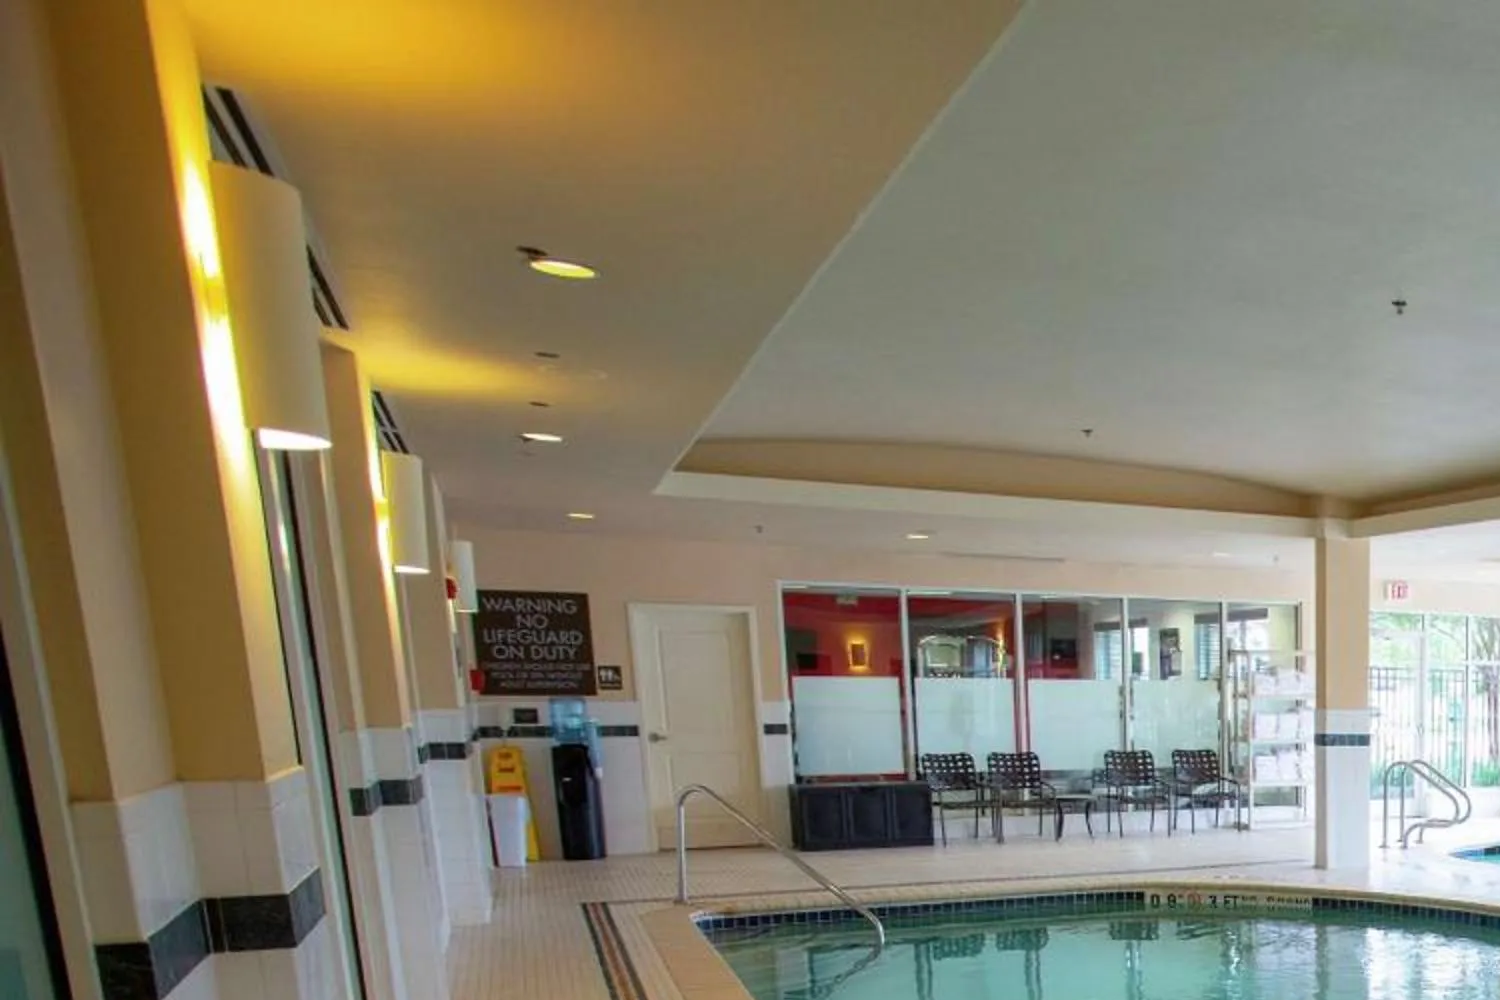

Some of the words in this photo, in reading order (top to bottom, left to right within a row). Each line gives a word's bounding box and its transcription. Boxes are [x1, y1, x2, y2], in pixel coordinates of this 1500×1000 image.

[482, 597, 577, 615] WARNING
[516, 614, 549, 630] NO
[483, 628, 583, 645] LIFEGUARD
[493, 645, 524, 659] ON
[530, 645, 577, 660] DUTY
